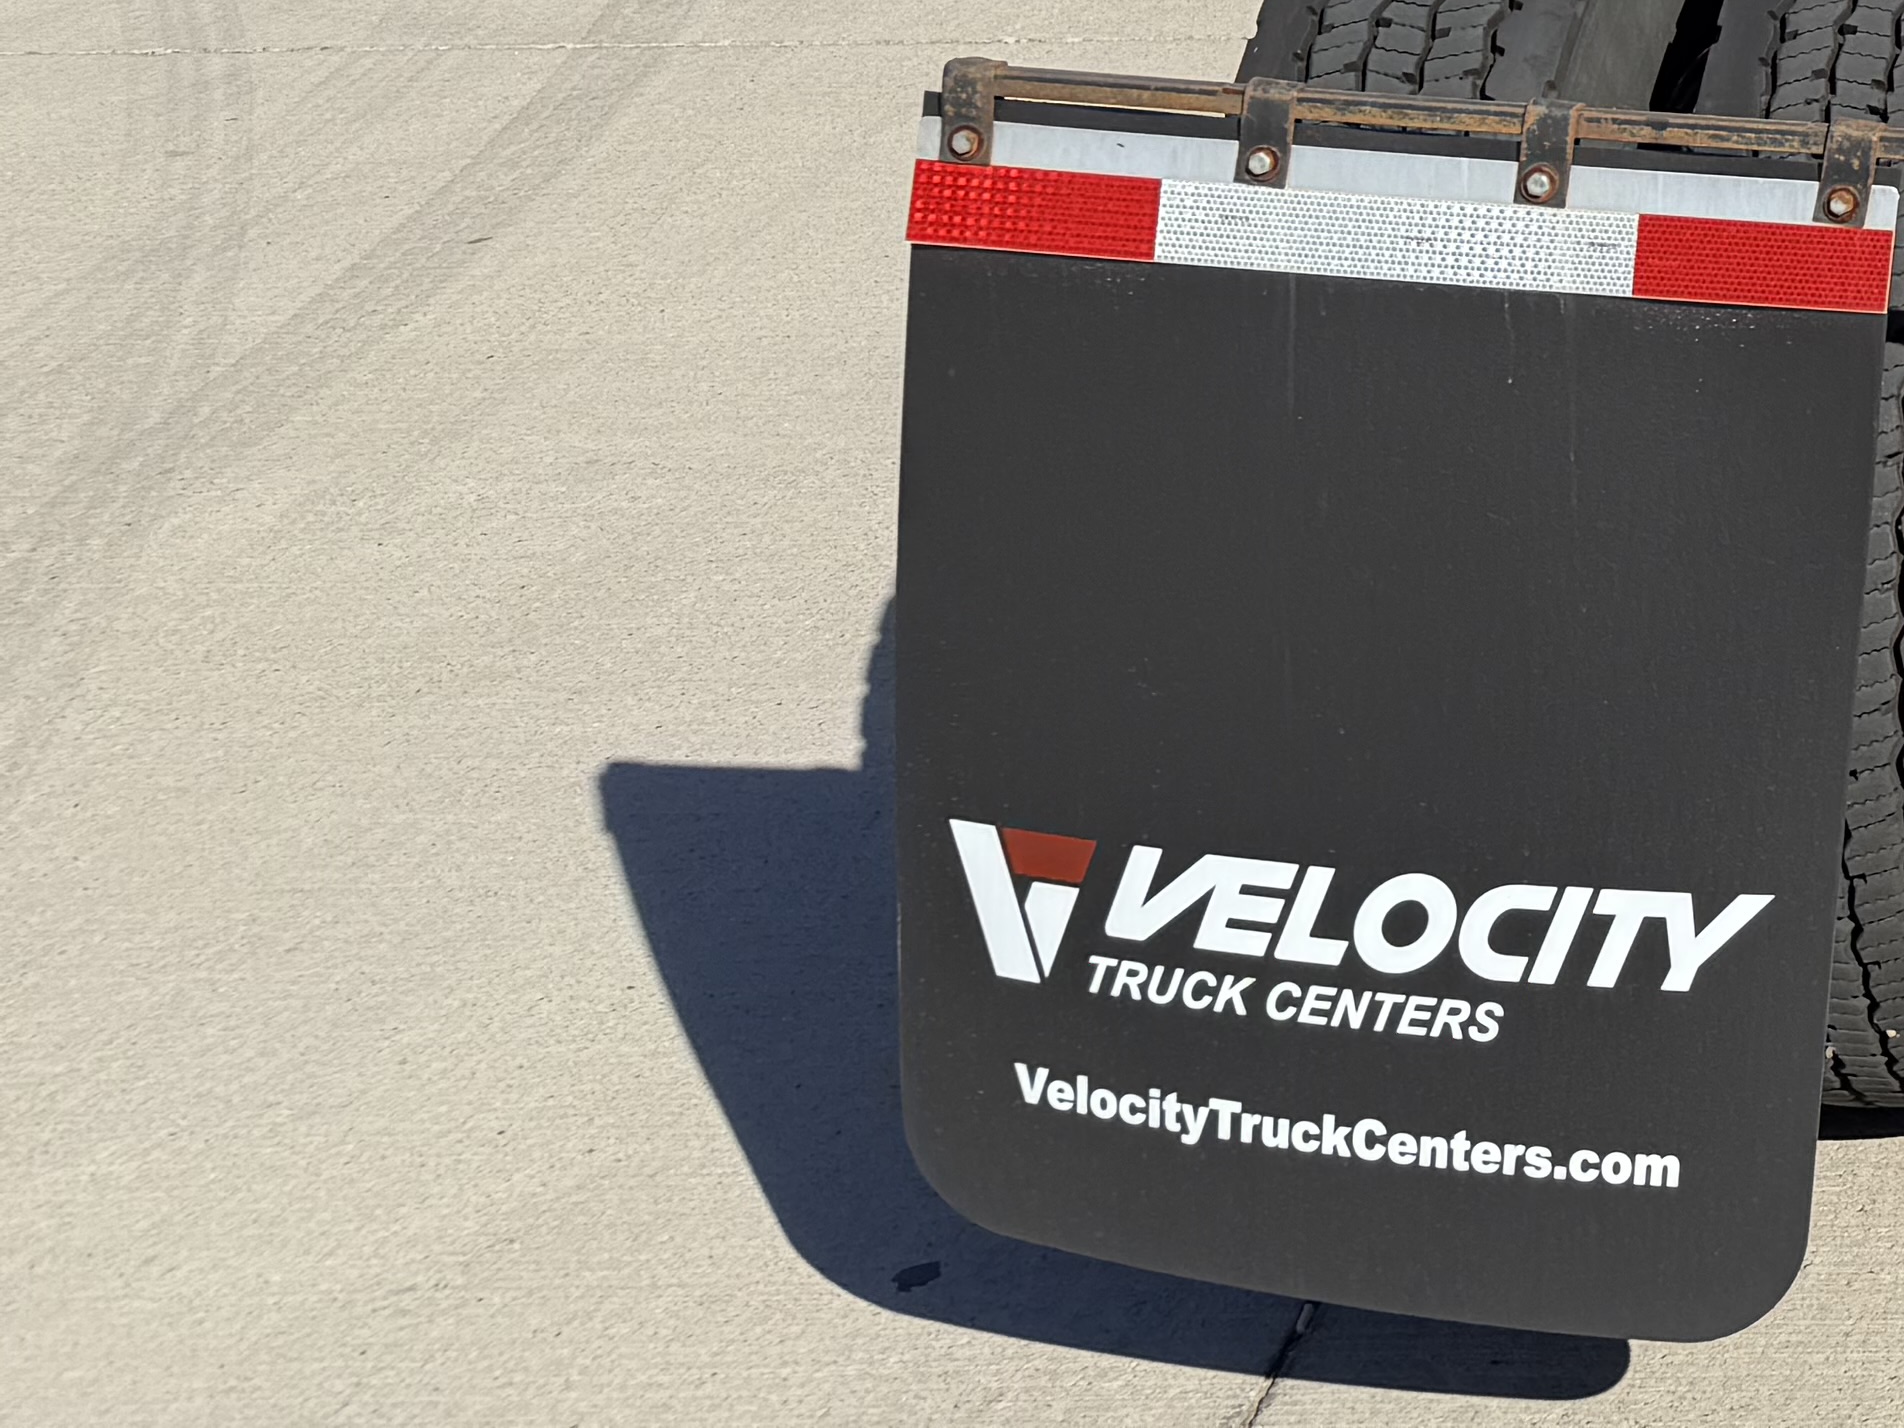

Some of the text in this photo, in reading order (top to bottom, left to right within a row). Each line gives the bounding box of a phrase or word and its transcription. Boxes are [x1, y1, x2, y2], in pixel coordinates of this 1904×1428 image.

[1105, 846, 1776, 992] VELOCITY
[1088, 956, 1505, 1043] TRUCK CENTERS
[1014, 1063, 1681, 1188] VelocityTruckCenters.com
